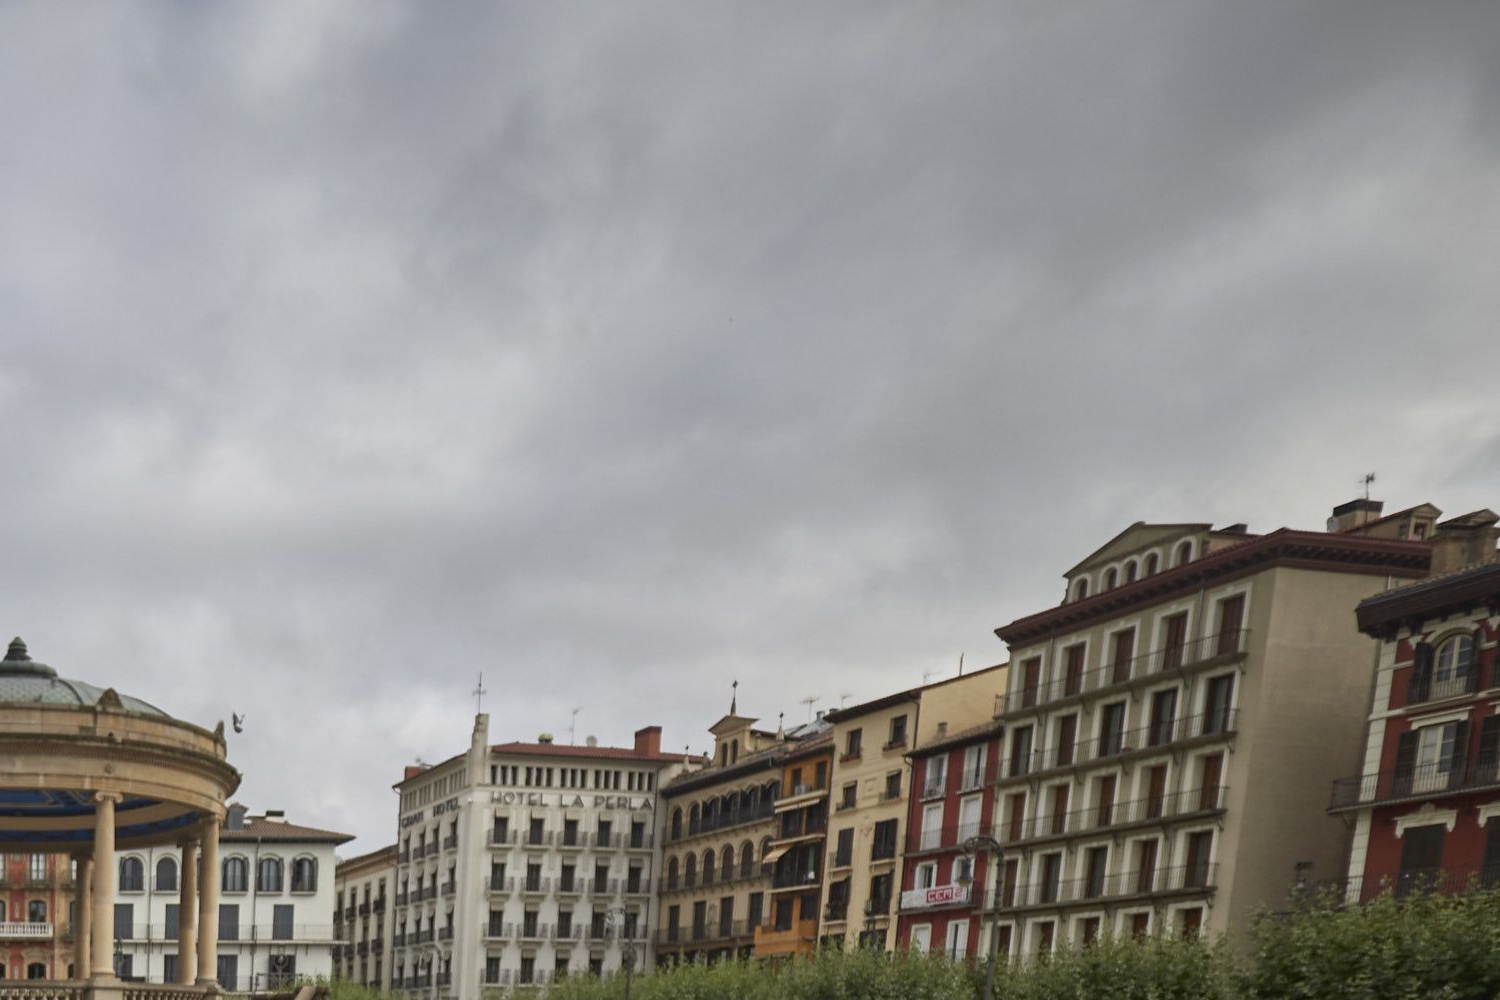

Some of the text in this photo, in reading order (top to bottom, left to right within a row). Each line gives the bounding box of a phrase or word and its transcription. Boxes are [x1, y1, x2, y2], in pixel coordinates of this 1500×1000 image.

[432, 796, 461, 817] HOTEL
[491, 791, 652, 811] HOTEL LA PERLA
